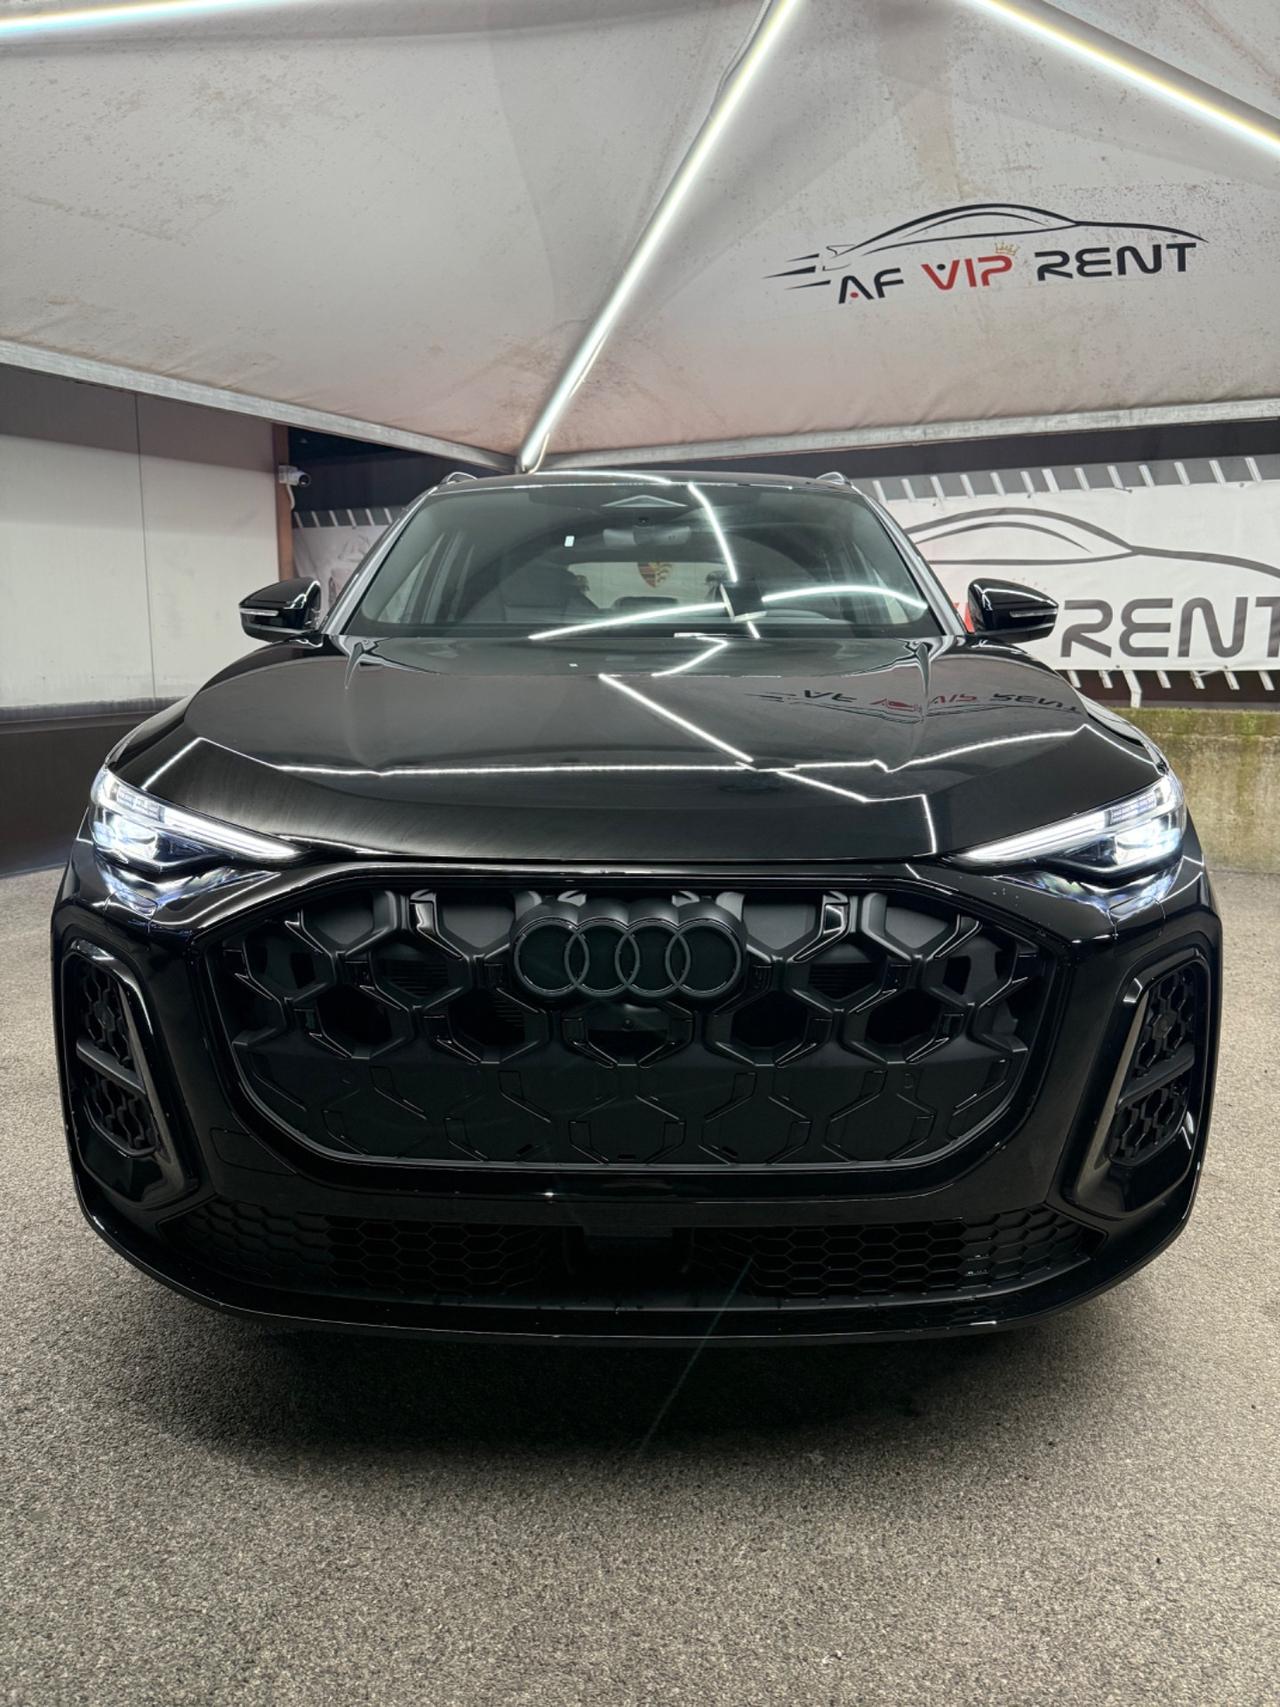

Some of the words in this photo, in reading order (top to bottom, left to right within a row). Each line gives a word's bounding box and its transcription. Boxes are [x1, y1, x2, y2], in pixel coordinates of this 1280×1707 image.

[838, 267, 904, 304] AF
[921, 253, 1013, 291] VIP
[1034, 242, 1197, 281] RENT
